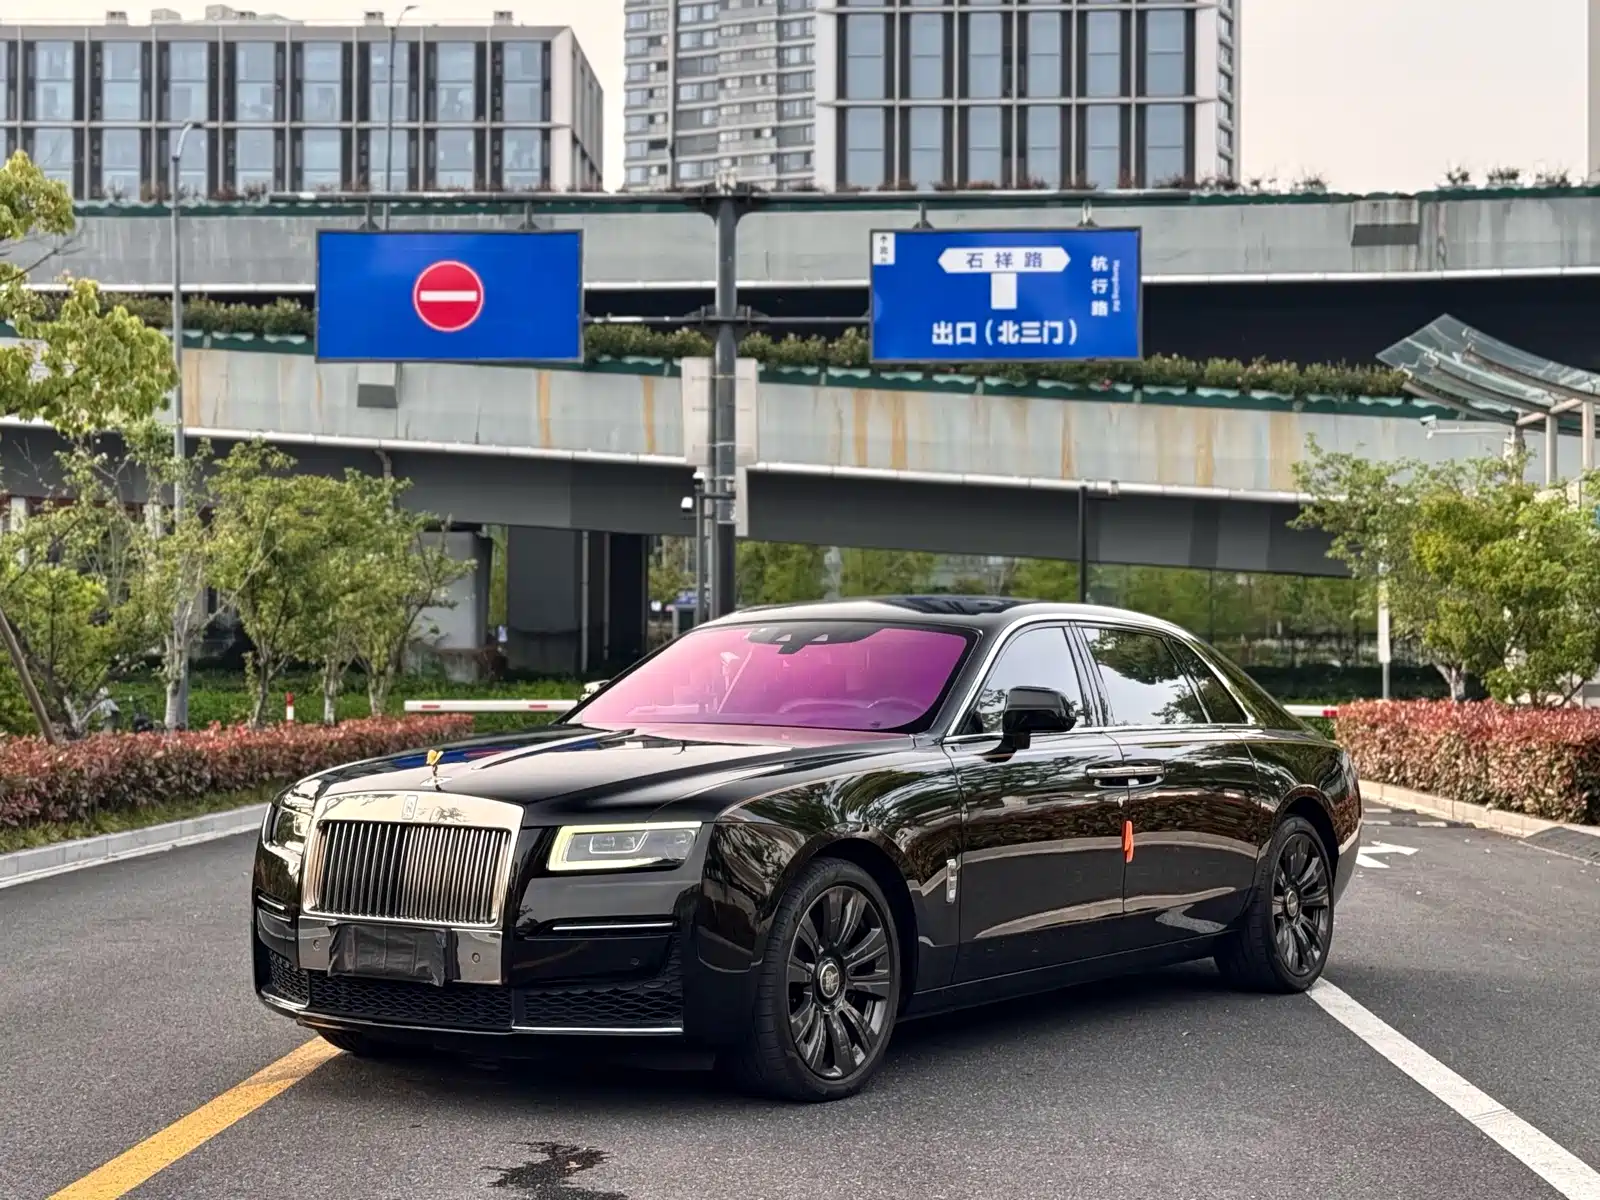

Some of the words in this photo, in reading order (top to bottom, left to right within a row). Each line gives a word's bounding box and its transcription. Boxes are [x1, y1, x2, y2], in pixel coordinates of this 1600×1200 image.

[966, 251, 1043, 269] 石祥路
[1090, 255, 1109, 317] 杭行路
[931, 318, 1078, 346] 出口（北三门）
